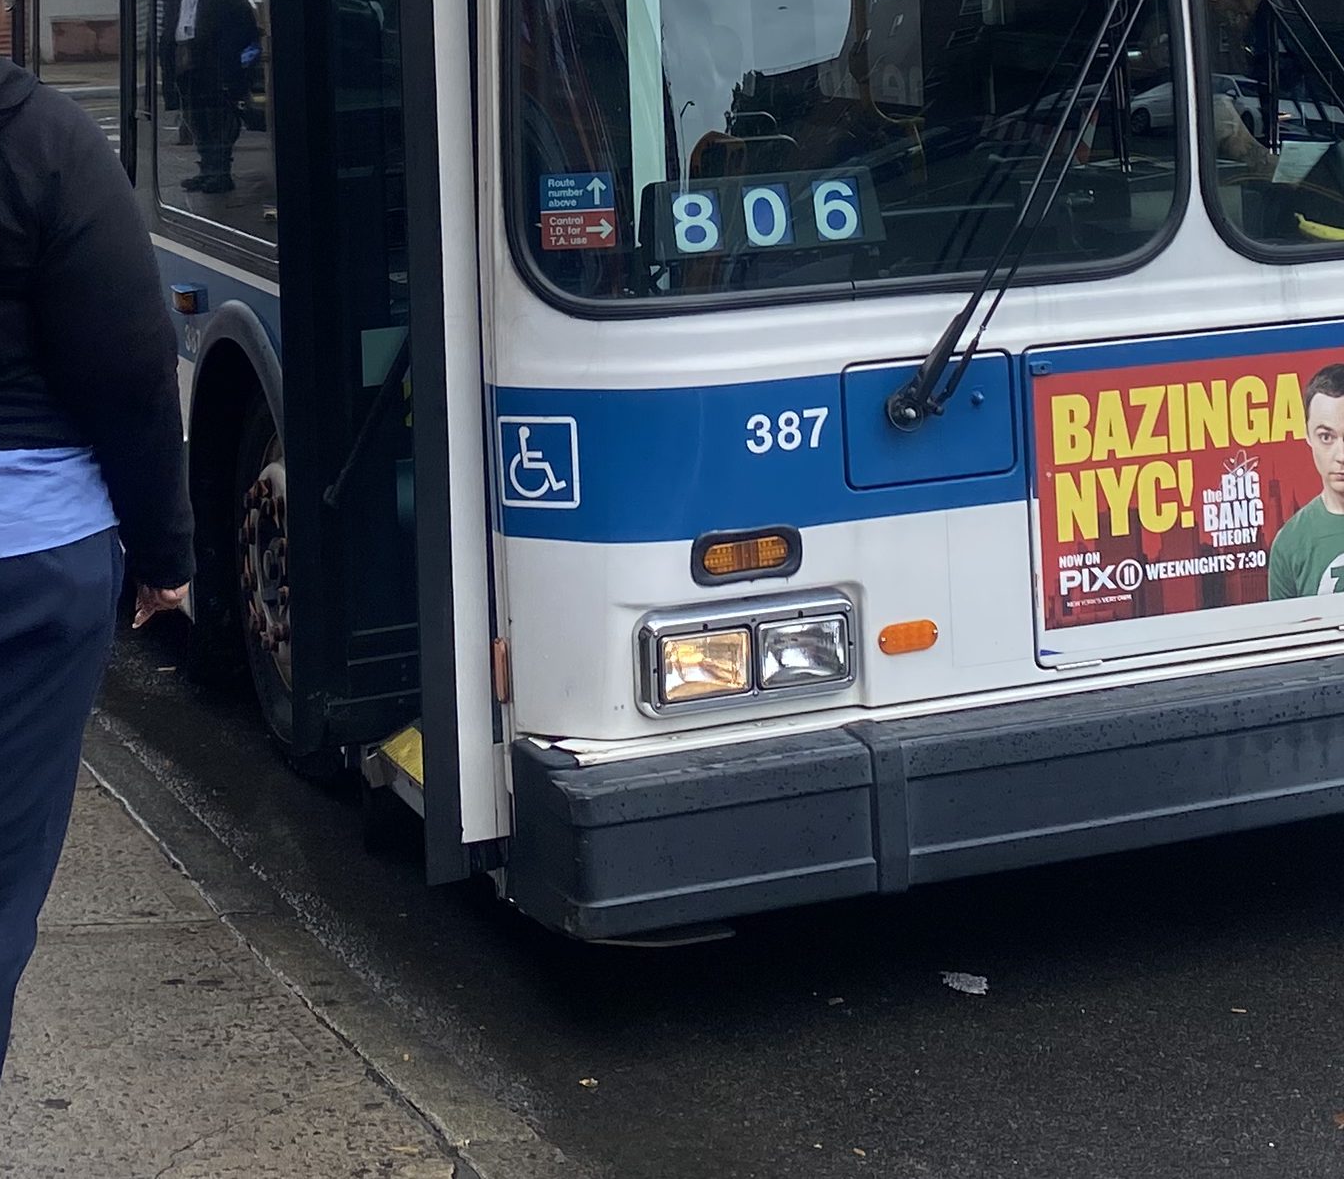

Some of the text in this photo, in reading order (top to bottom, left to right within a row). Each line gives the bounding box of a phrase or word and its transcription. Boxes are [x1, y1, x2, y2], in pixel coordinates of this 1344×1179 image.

[547, 178, 576, 188] Route
[548, 188, 584, 198] number
[548, 199, 577, 208] above
[549, 215, 584, 226] Control
[568, 226, 581, 235] for
[570, 237, 587, 245] use
[1051, 372, 1308, 466] BAZINGA
[745, 406, 830, 455] 387
[1055, 458, 1196, 544] NYC!
[1203, 499, 1265, 533] BANG
[1210, 527, 1258, 548] THEORY
[1059, 551, 1101, 569] NOW ON
[1145, 554, 1235, 582] WEEKNIGHTS
[1237, 550, 1267, 570] 7:30
